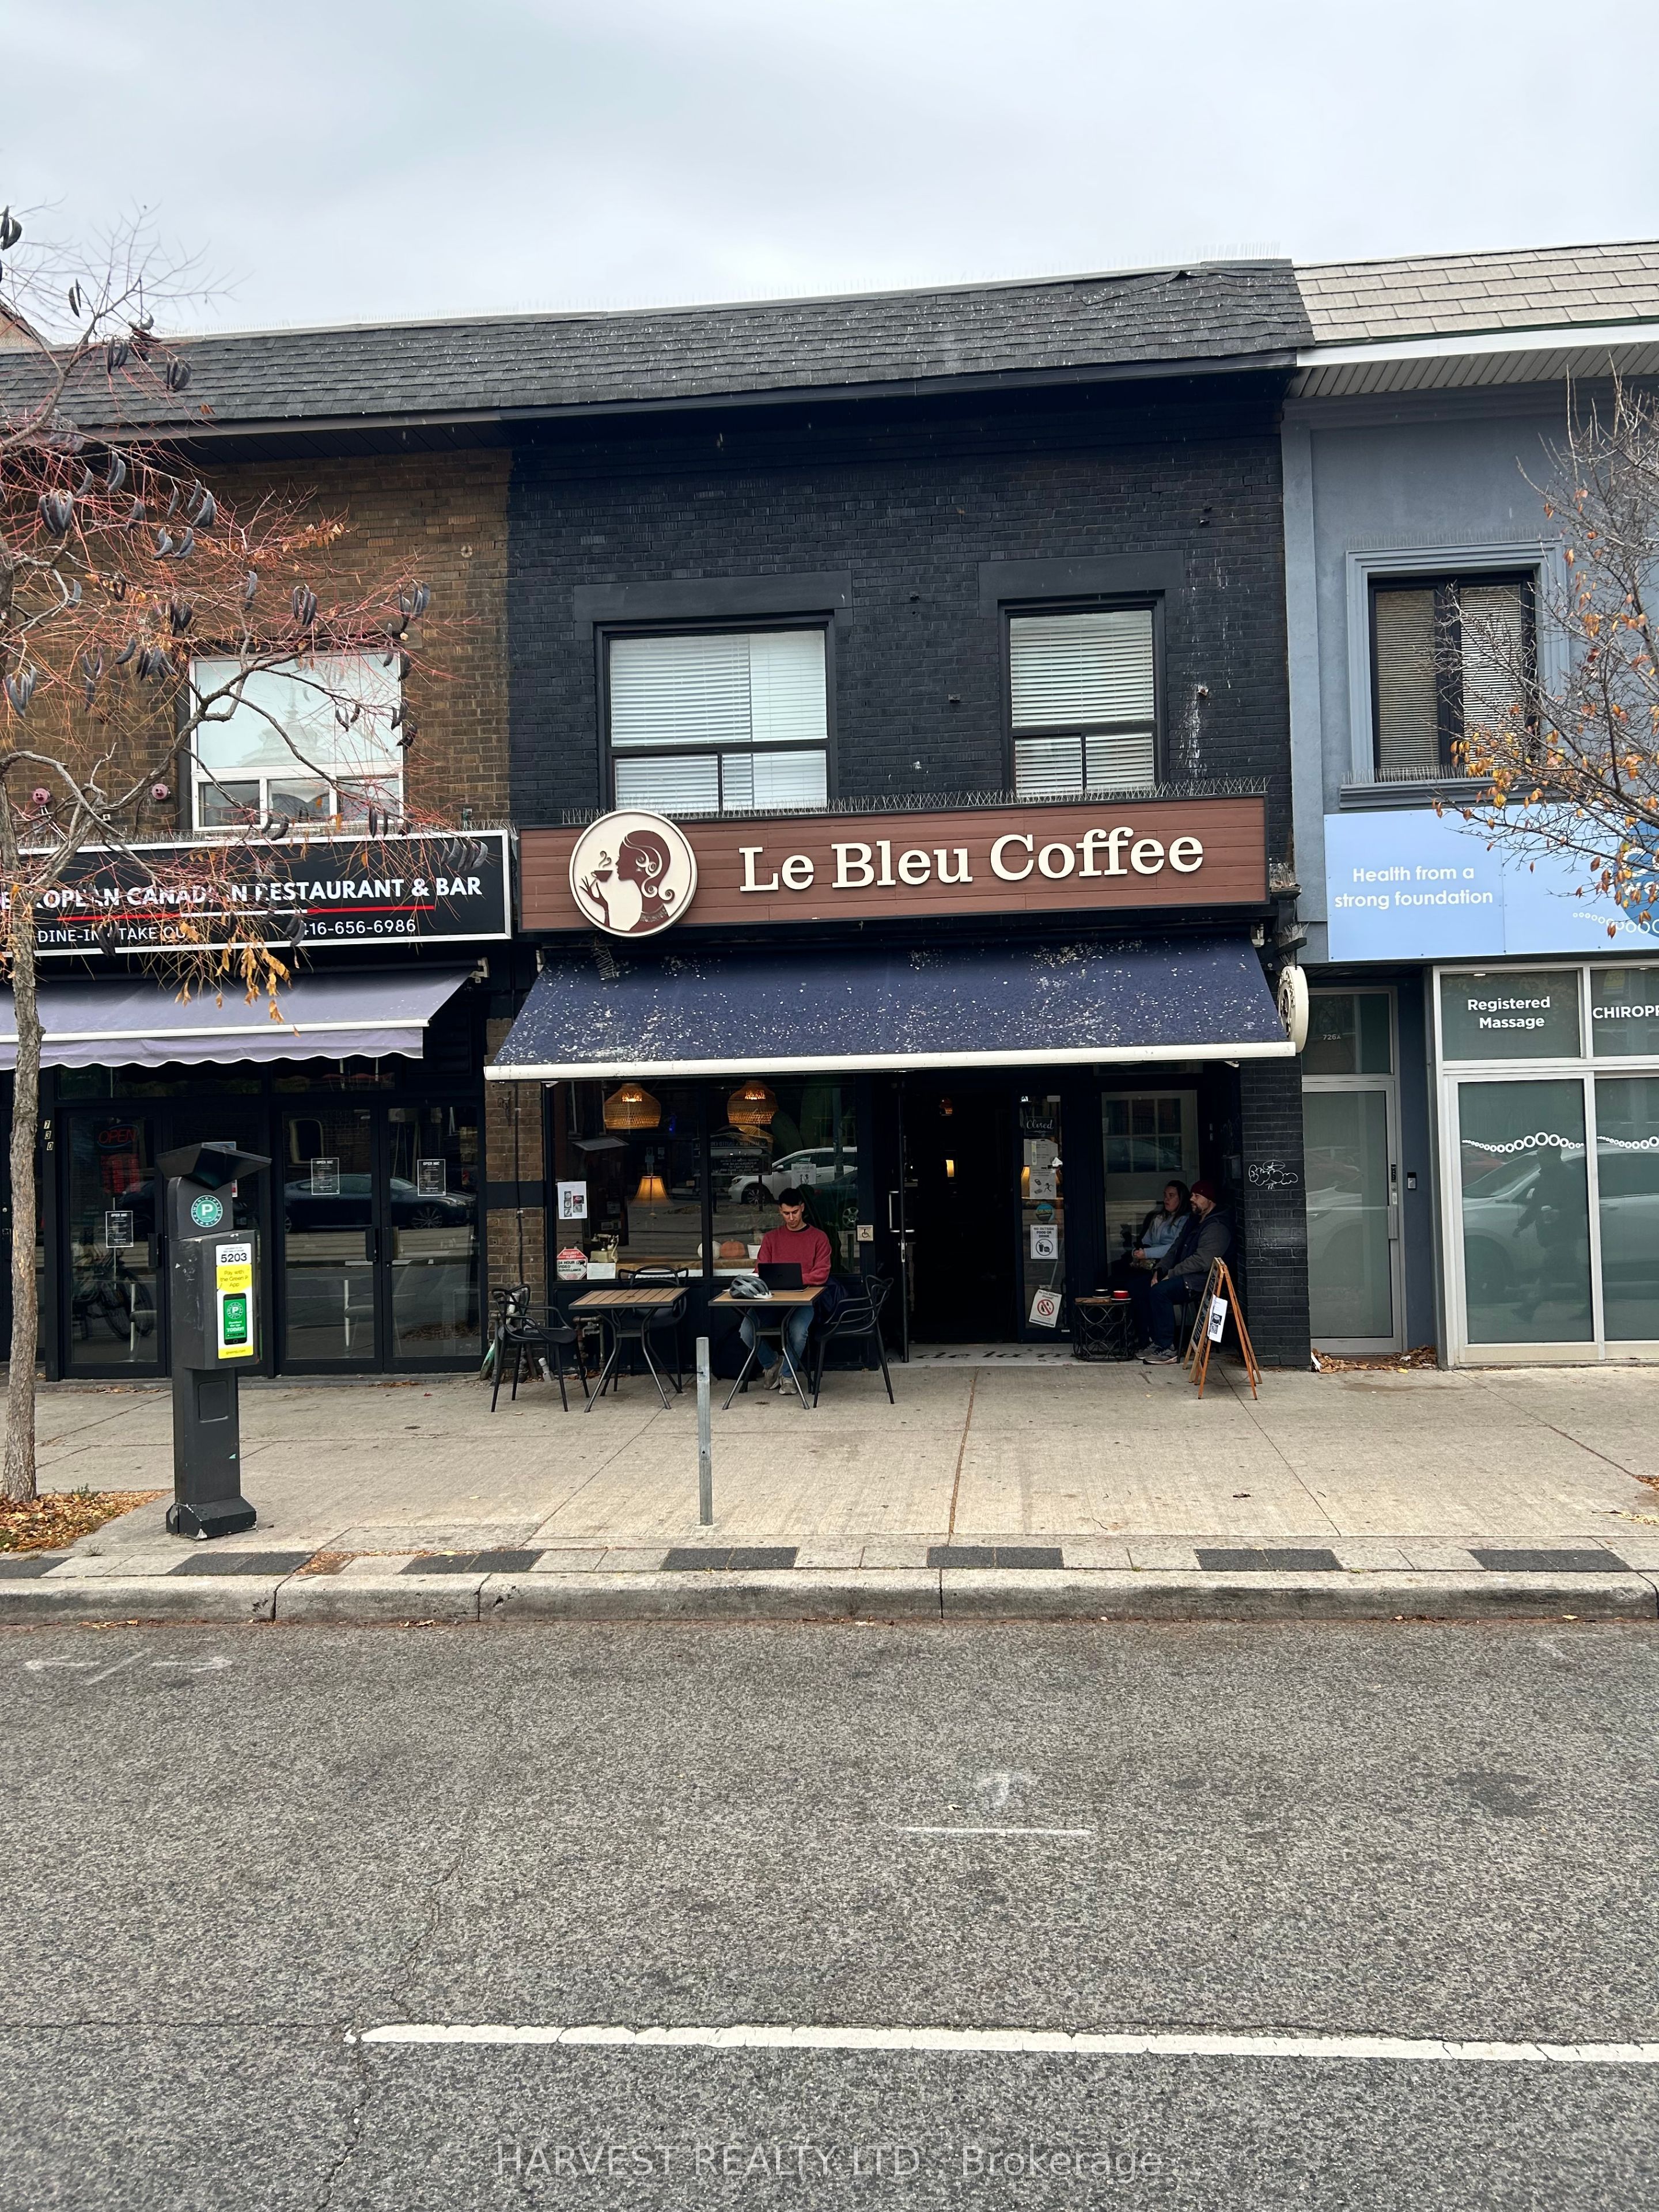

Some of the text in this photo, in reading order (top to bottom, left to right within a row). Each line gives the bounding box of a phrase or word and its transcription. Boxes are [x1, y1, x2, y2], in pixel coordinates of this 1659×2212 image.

[738, 826, 1204, 892] Le Bleu Coffee
[1353, 865, 1475, 882] Health from a
[255, 879, 404, 902] RESTAURANT
[411, 877, 431, 897] &
[436, 876, 483, 896] BAR
[1334, 889, 1493, 910] strong foundation
[118, 926, 158, 940] TAKE
[164, 926, 197, 939] OU
[1467, 996, 1551, 1012] Registered
[1479, 1017, 1546, 1030] Massage
[1027, 1119, 1054, 1130] Closed
[99, 1129, 137, 1144] OPEN
[201, 1203, 214, 1216] P
[221, 1252, 247, 1263] 5203
